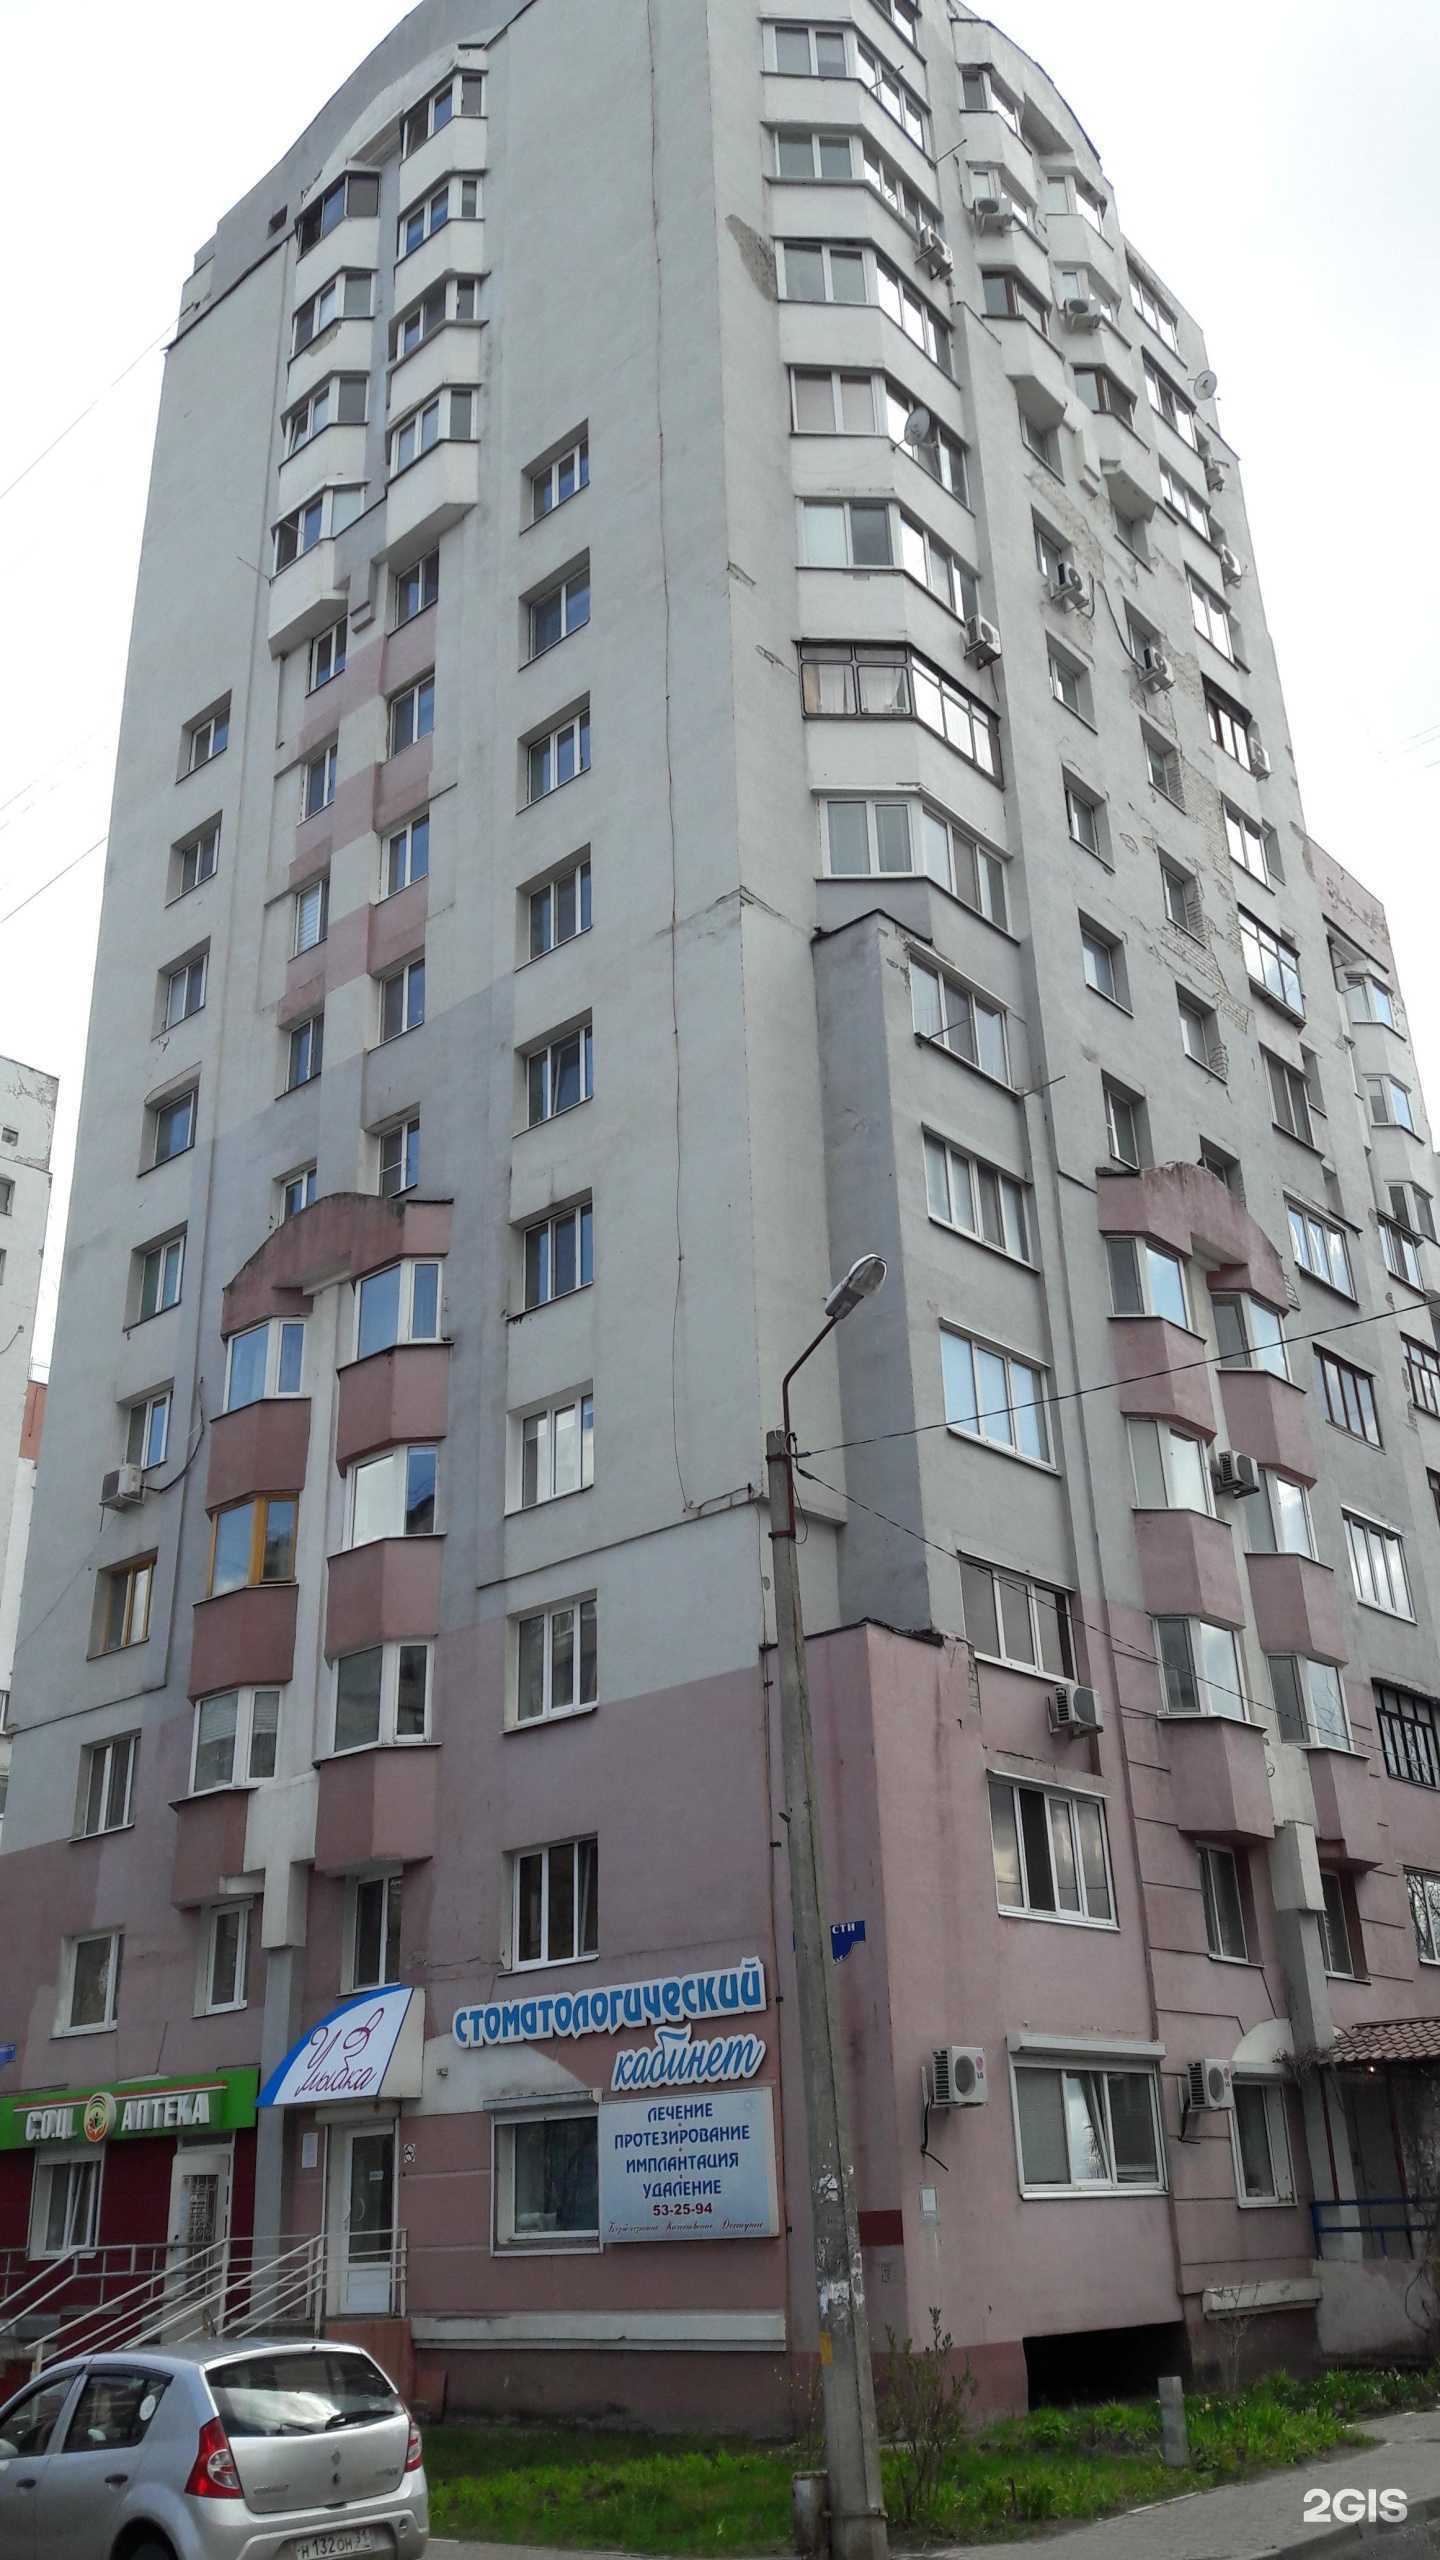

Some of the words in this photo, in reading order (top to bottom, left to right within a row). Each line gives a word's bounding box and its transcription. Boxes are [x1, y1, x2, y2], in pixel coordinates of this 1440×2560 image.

[616, 2031, 763, 2086] кабинет
[121, 2093, 210, 2131] АПТЕКА
[648, 2102, 713, 2122] ЛЕЧЕНИЕ
[615, 2125, 750, 2149] ПРОТЕЗИРОВАНИЕ
[626, 2152, 739, 2174] ИМПЛАНТАЦИЯ
[643, 2179, 722, 2199] УДАЛЕНИЕ
[653, 2202, 712, 2216] 53-25-94
